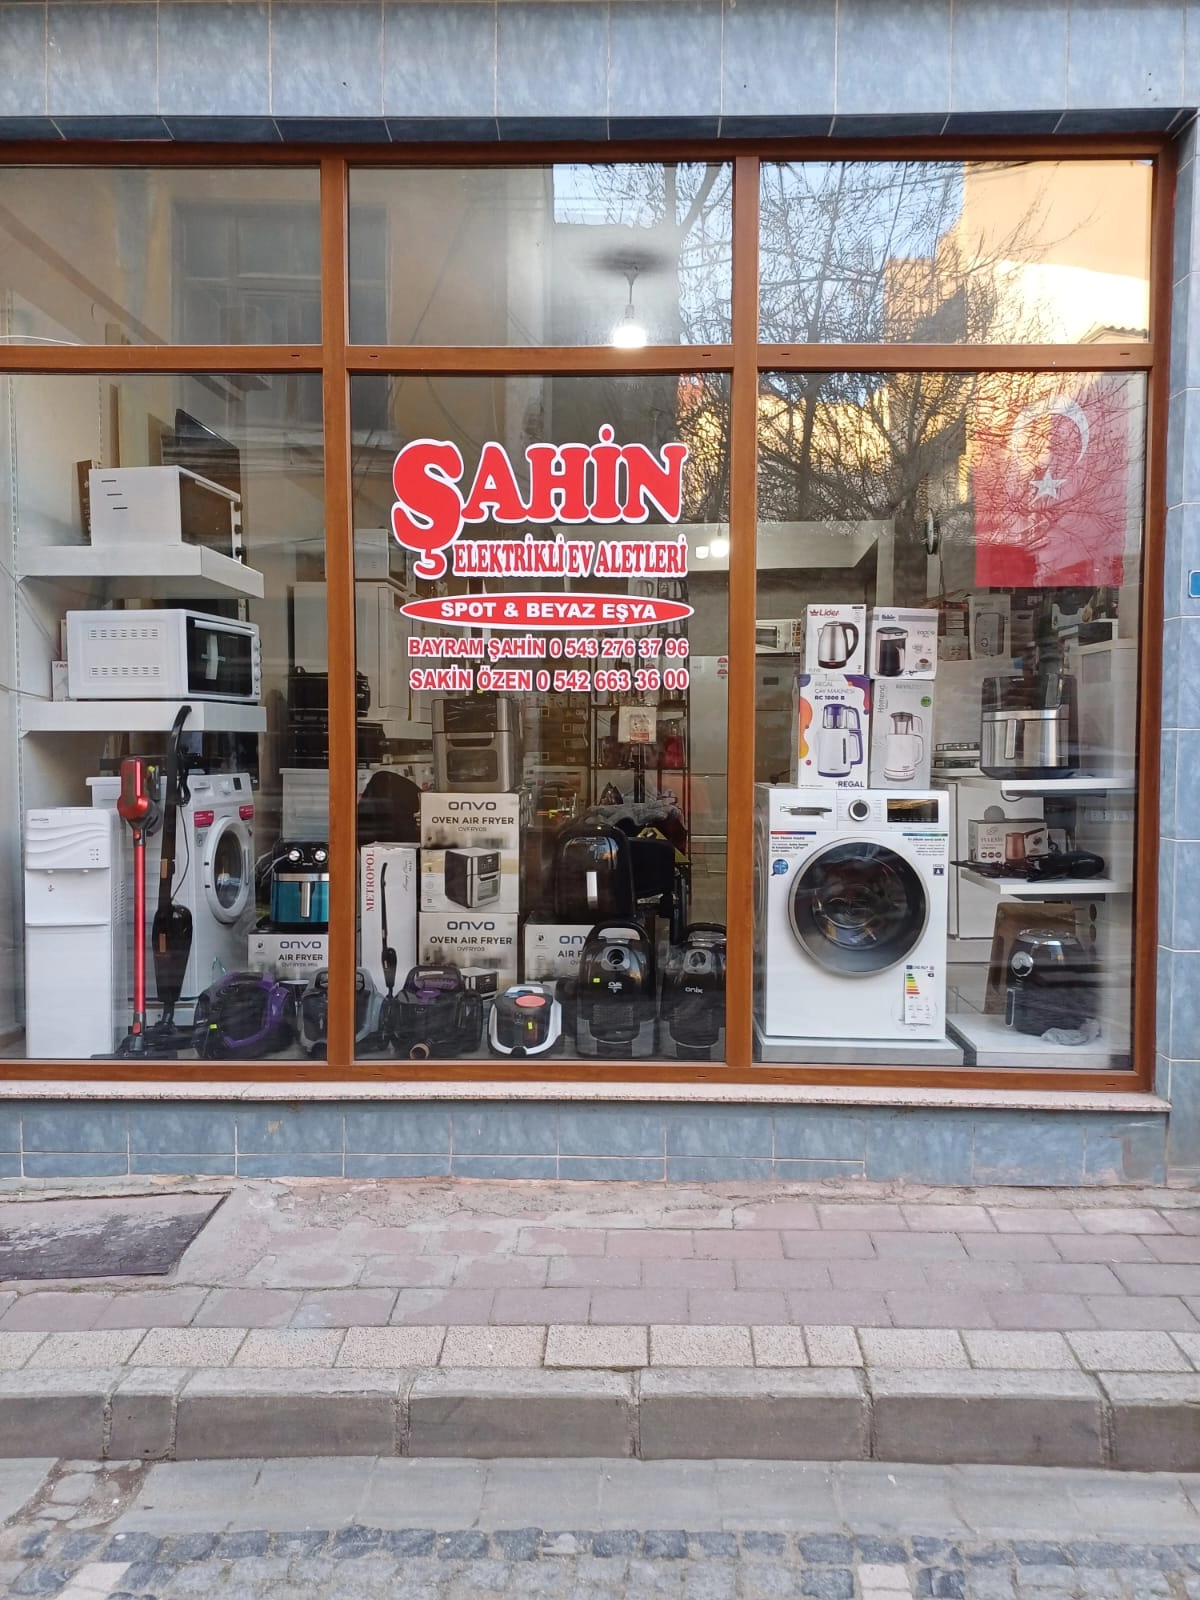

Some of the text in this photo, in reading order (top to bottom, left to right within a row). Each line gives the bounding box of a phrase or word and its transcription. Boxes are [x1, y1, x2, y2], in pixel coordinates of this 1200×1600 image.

[392, 424, 688, 578] ŞAHİN
[454, 535, 688, 577] ELEKTRİKLİ EV ALETLERİ
[441, 602, 657, 622] SPOT & BEYAZ EŞYA
[819, 608, 840, 617] Lider
[408, 635, 689, 662] BAYRAM ŞAHİN 0 543 276 37 96
[410, 665, 689, 691] SAKİN ÖZEN 0 542 663 36 00
[837, 780, 865, 788] REGAL
[431, 816, 514, 825] OVEN AIR FRYER
[366, 850, 375, 912] METROPOL
[430, 936, 512, 945] OVEN AIR FRYER
[278, 953, 323, 961] AIR FRYER
[557, 950, 575, 958] AIR
